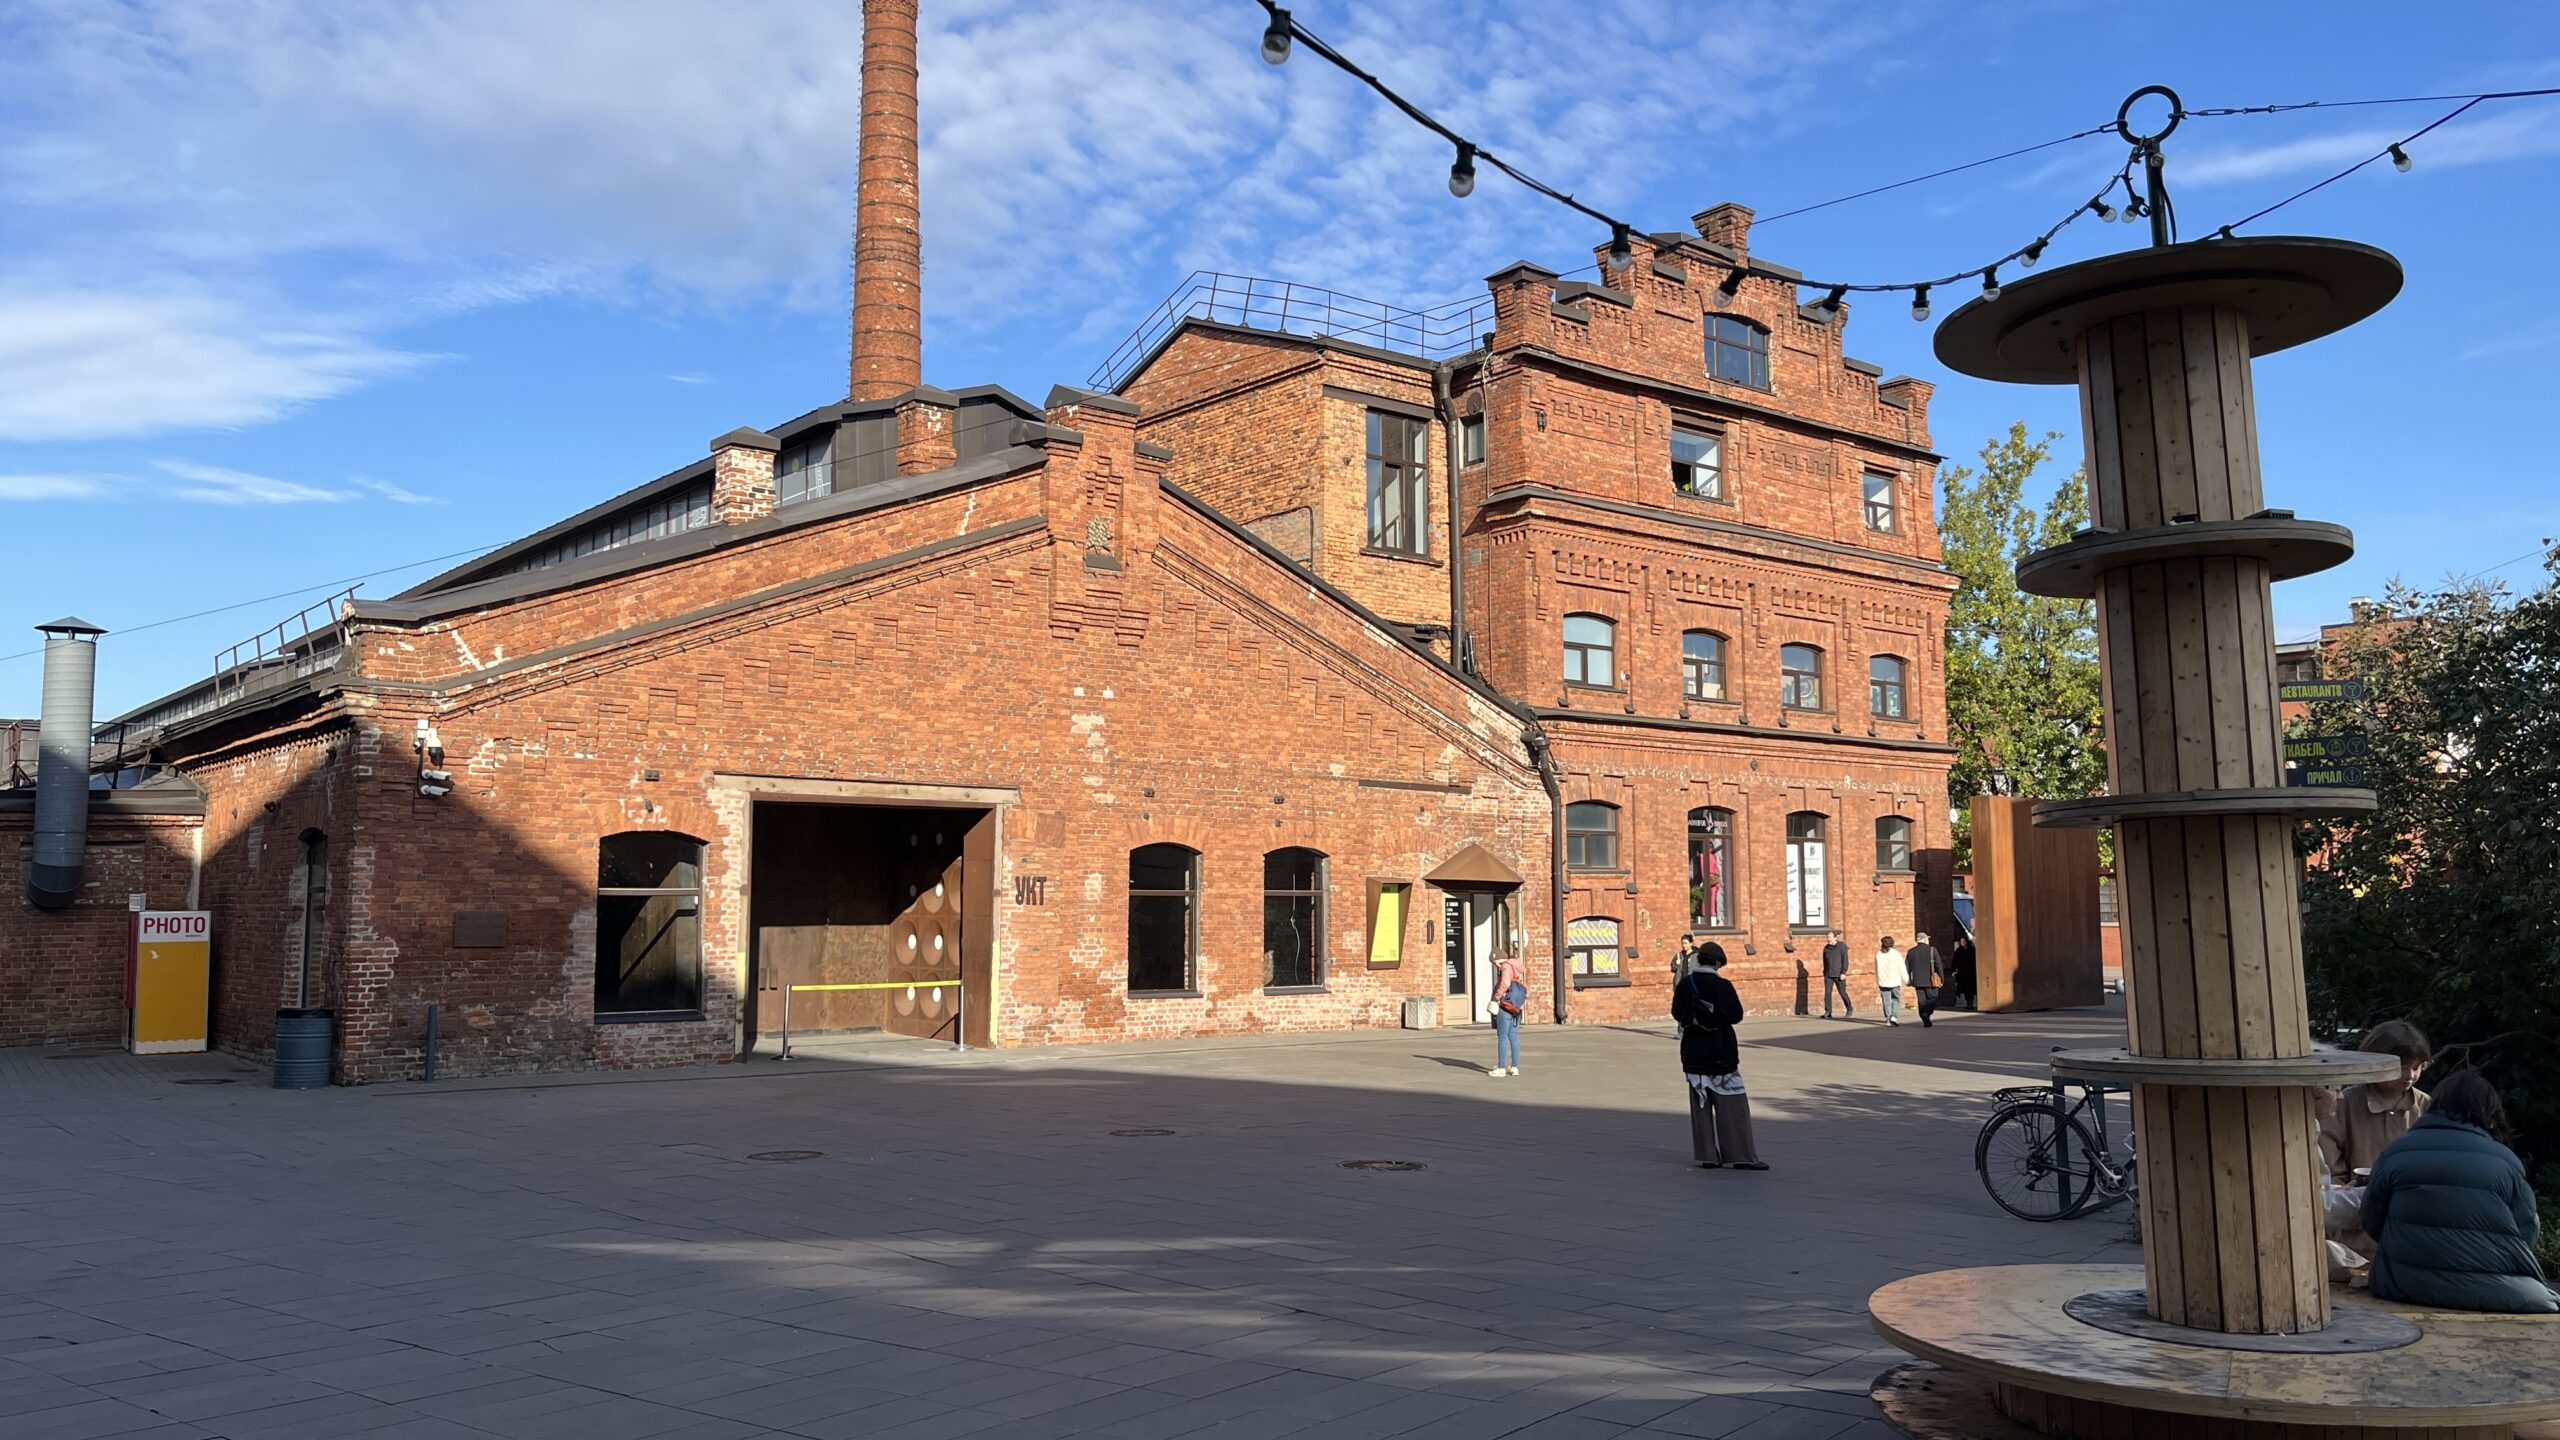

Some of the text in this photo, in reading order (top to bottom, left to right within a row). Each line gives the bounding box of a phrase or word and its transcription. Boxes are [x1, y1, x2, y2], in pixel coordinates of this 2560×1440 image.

[2281, 685, 2342, 698] RESTAURANTS
[2307, 771, 2342, 784] ПРИЧАЛ
[143, 916, 206, 934] PHOTO
